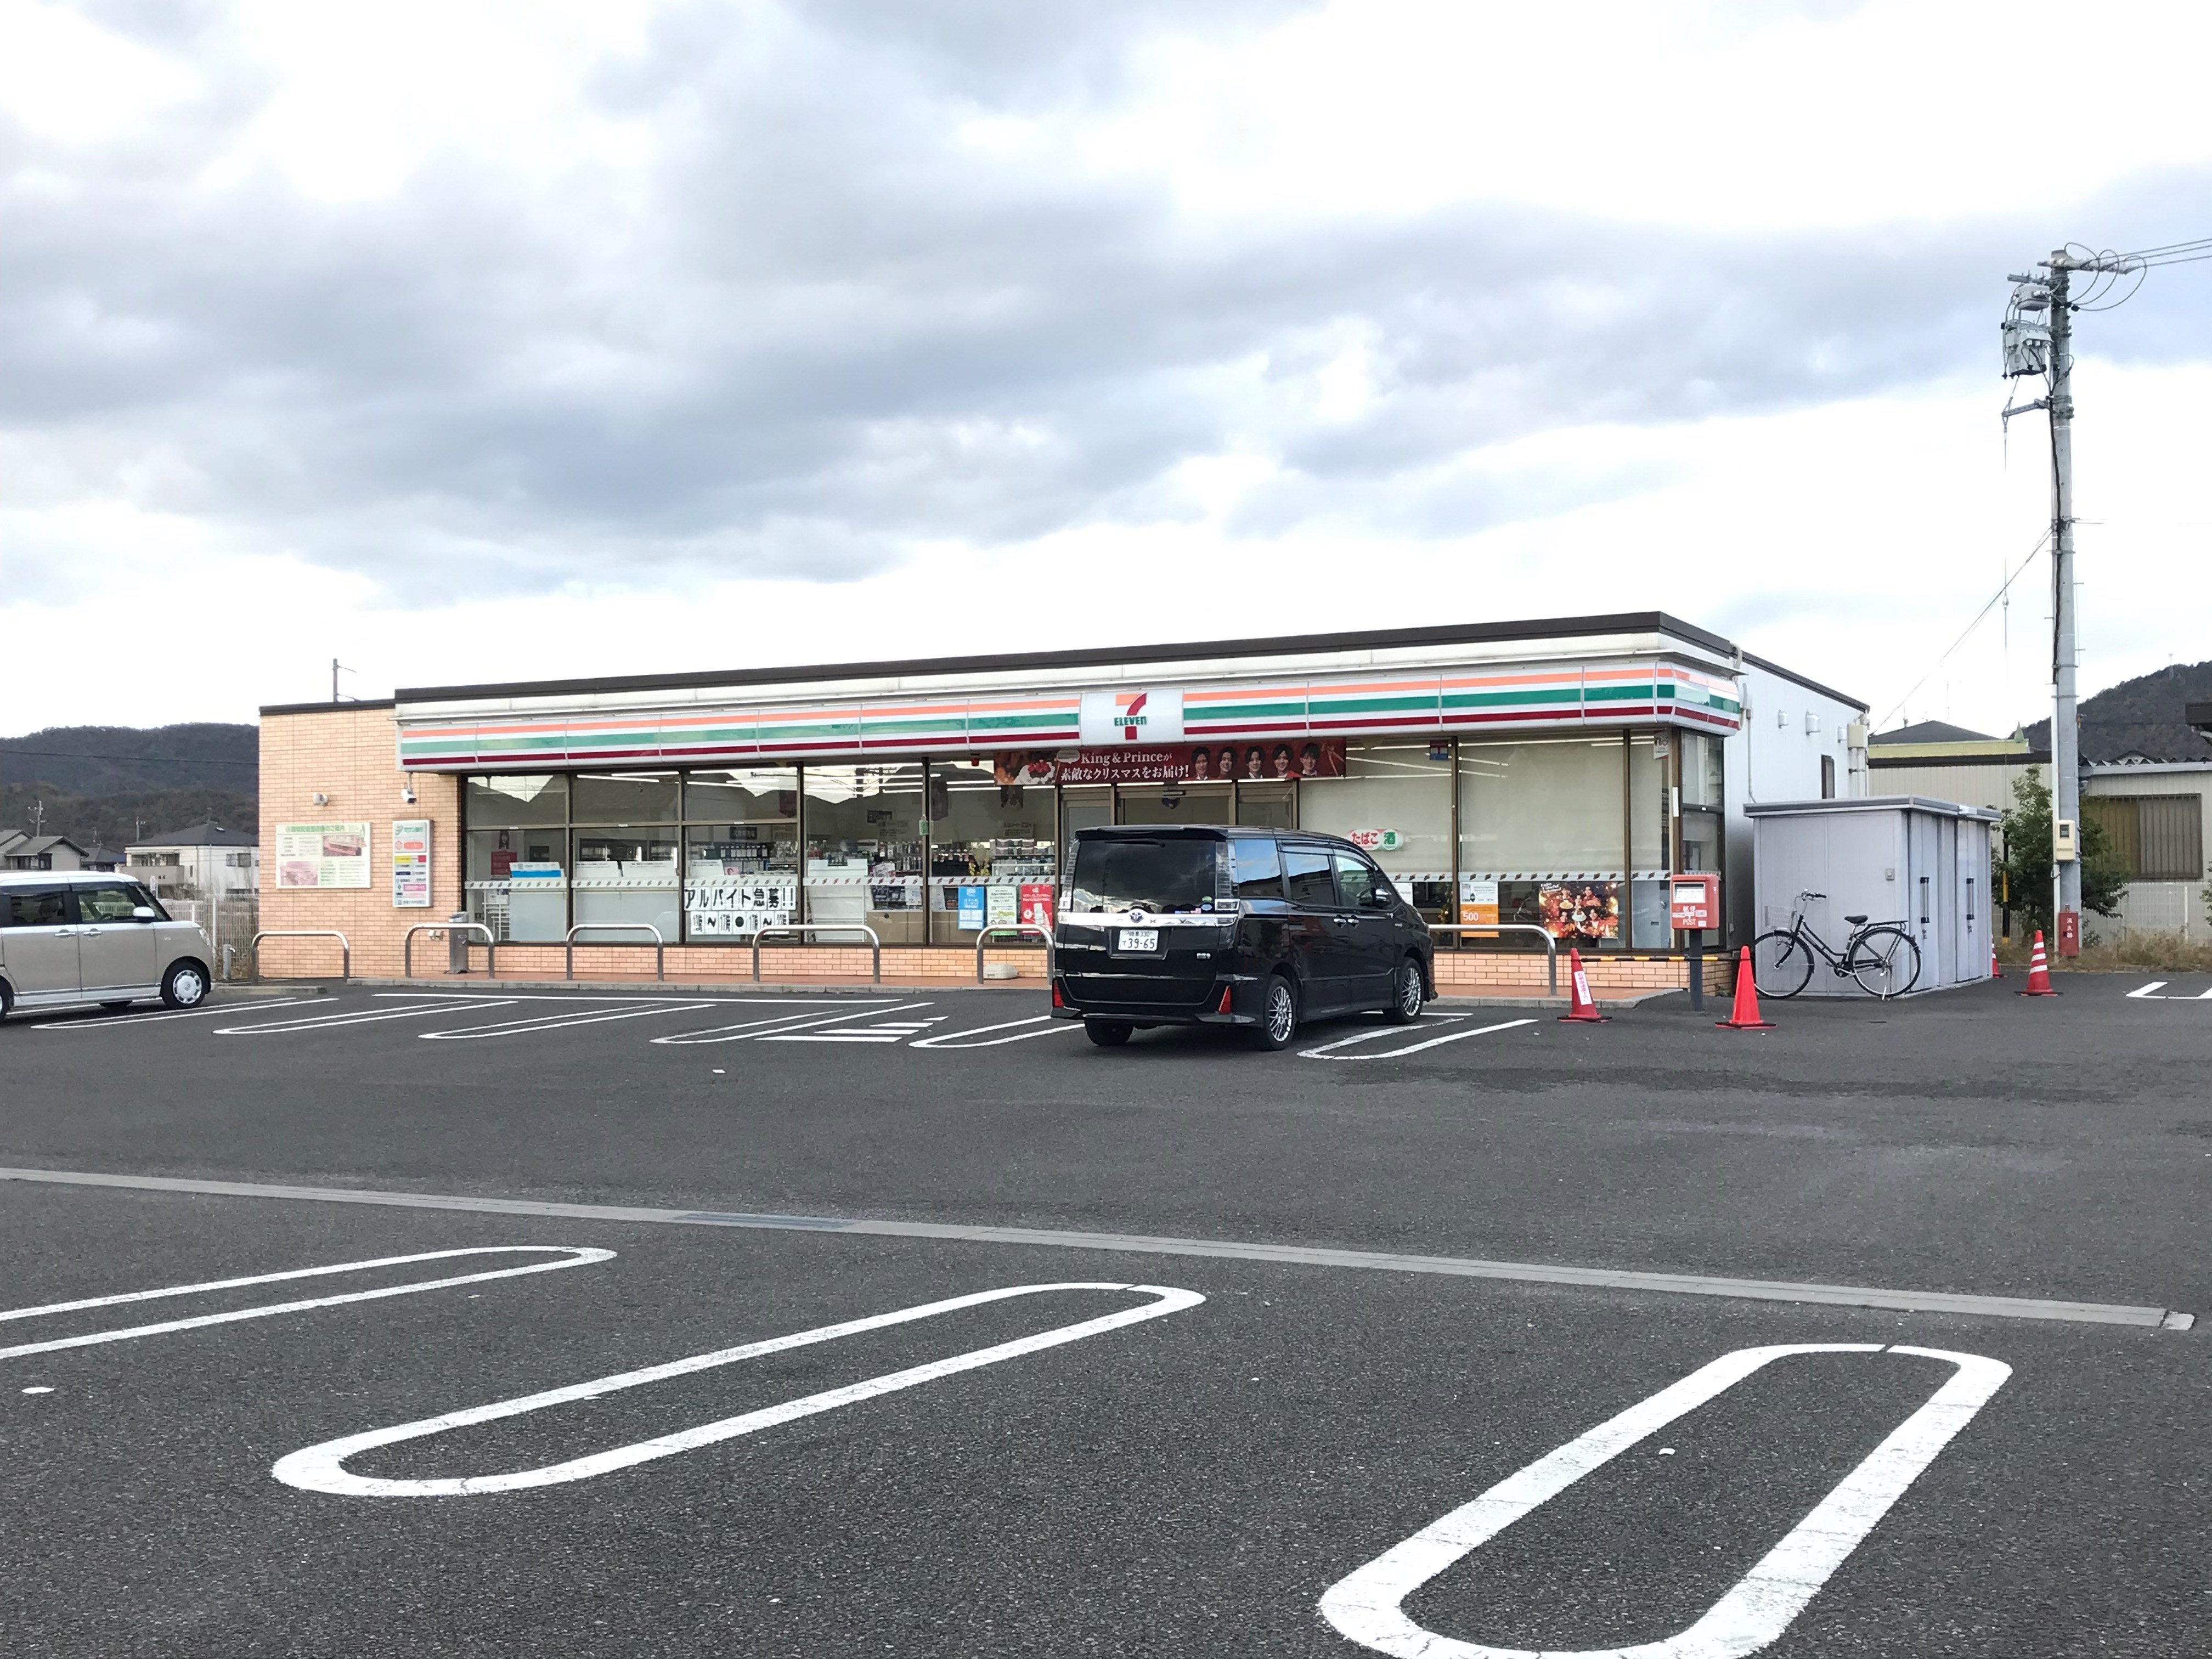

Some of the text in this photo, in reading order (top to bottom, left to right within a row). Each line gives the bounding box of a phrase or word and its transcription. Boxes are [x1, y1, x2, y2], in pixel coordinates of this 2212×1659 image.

[1081, 752, 1111, 766] King
[1112, 753, 1121, 763] &
[1351, 831, 1396, 845] たばこ 酒
[1463, 912, 1480, 921] 500
[1127, 938, 1155, 949] 39-65
